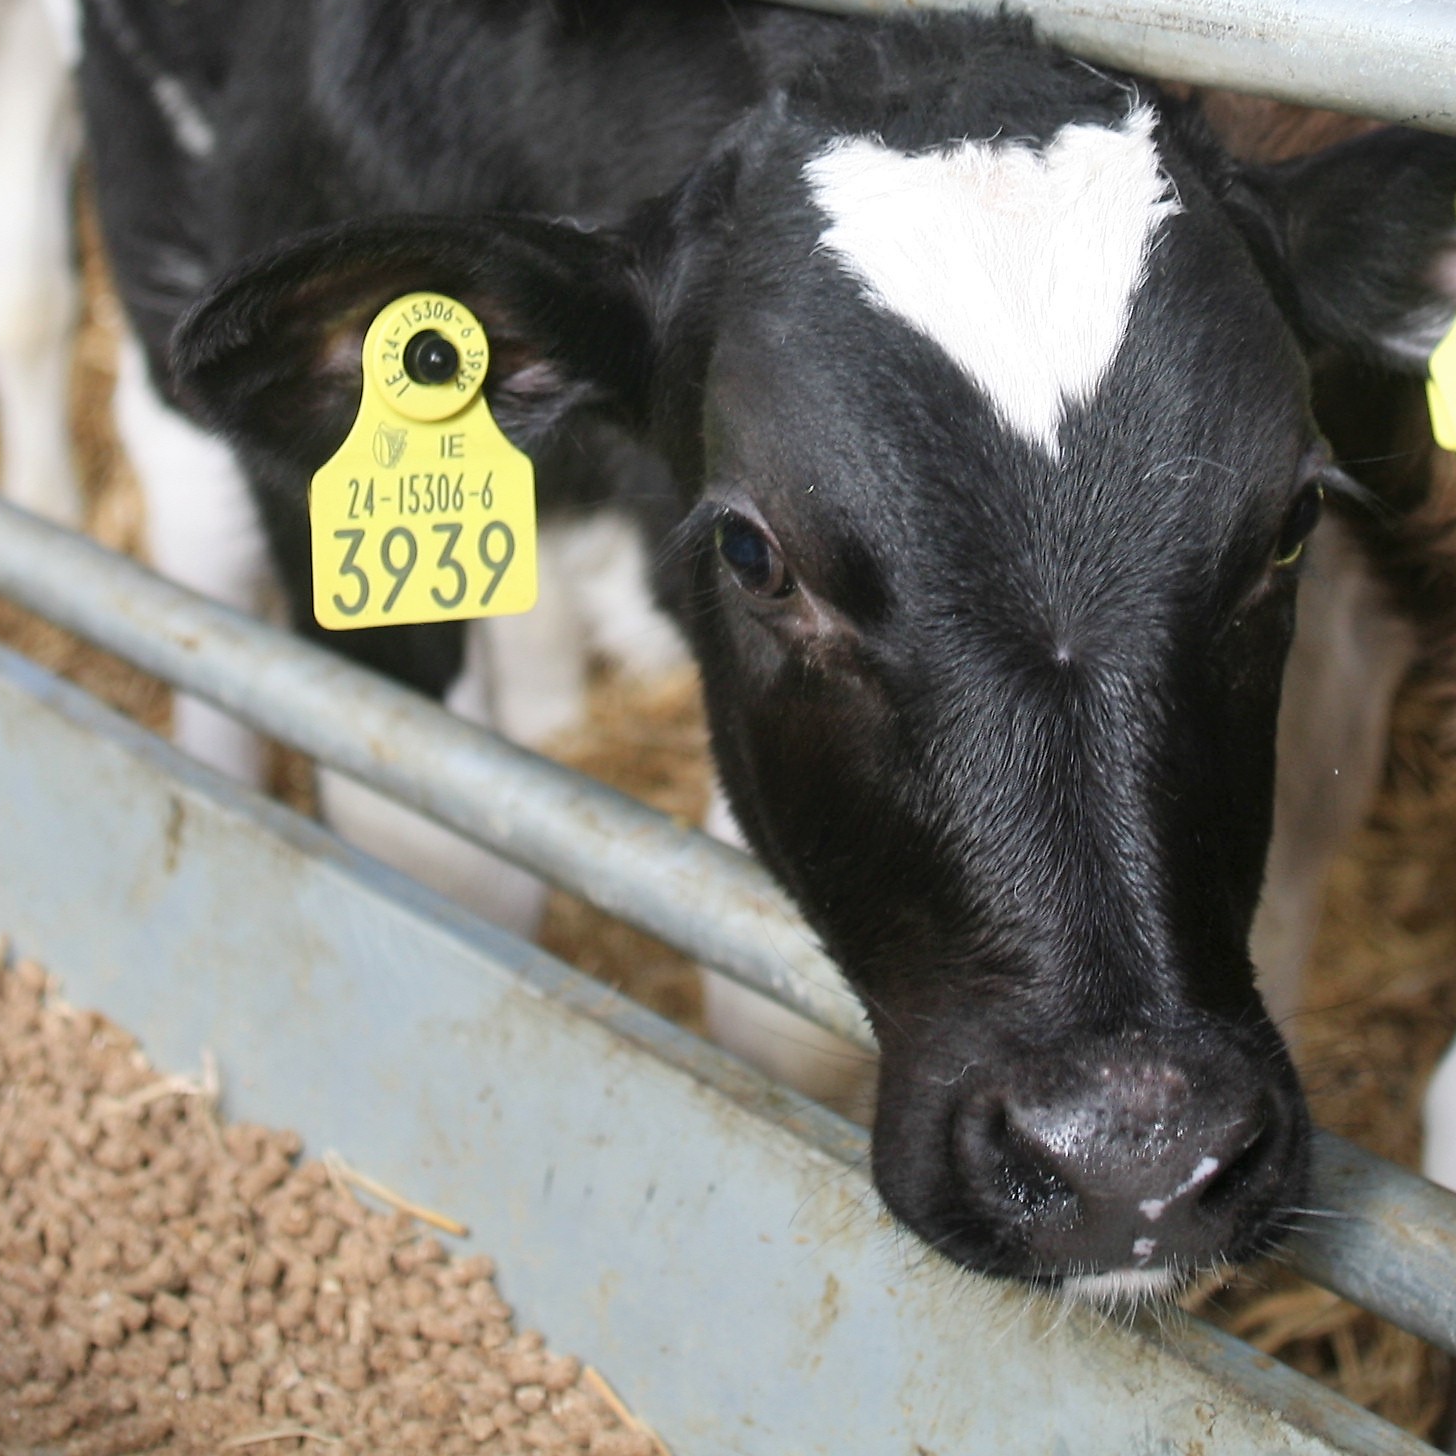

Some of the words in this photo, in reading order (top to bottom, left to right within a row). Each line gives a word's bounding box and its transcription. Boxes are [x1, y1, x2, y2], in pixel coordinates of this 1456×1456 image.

[382, 300, 475, 362] 24-15306-6
[456, 348, 484, 393] 3939
[440, 433, 466, 459] IE
[348, 471, 494, 519] 24-15306-6
[332, 520, 516, 617] 3939
